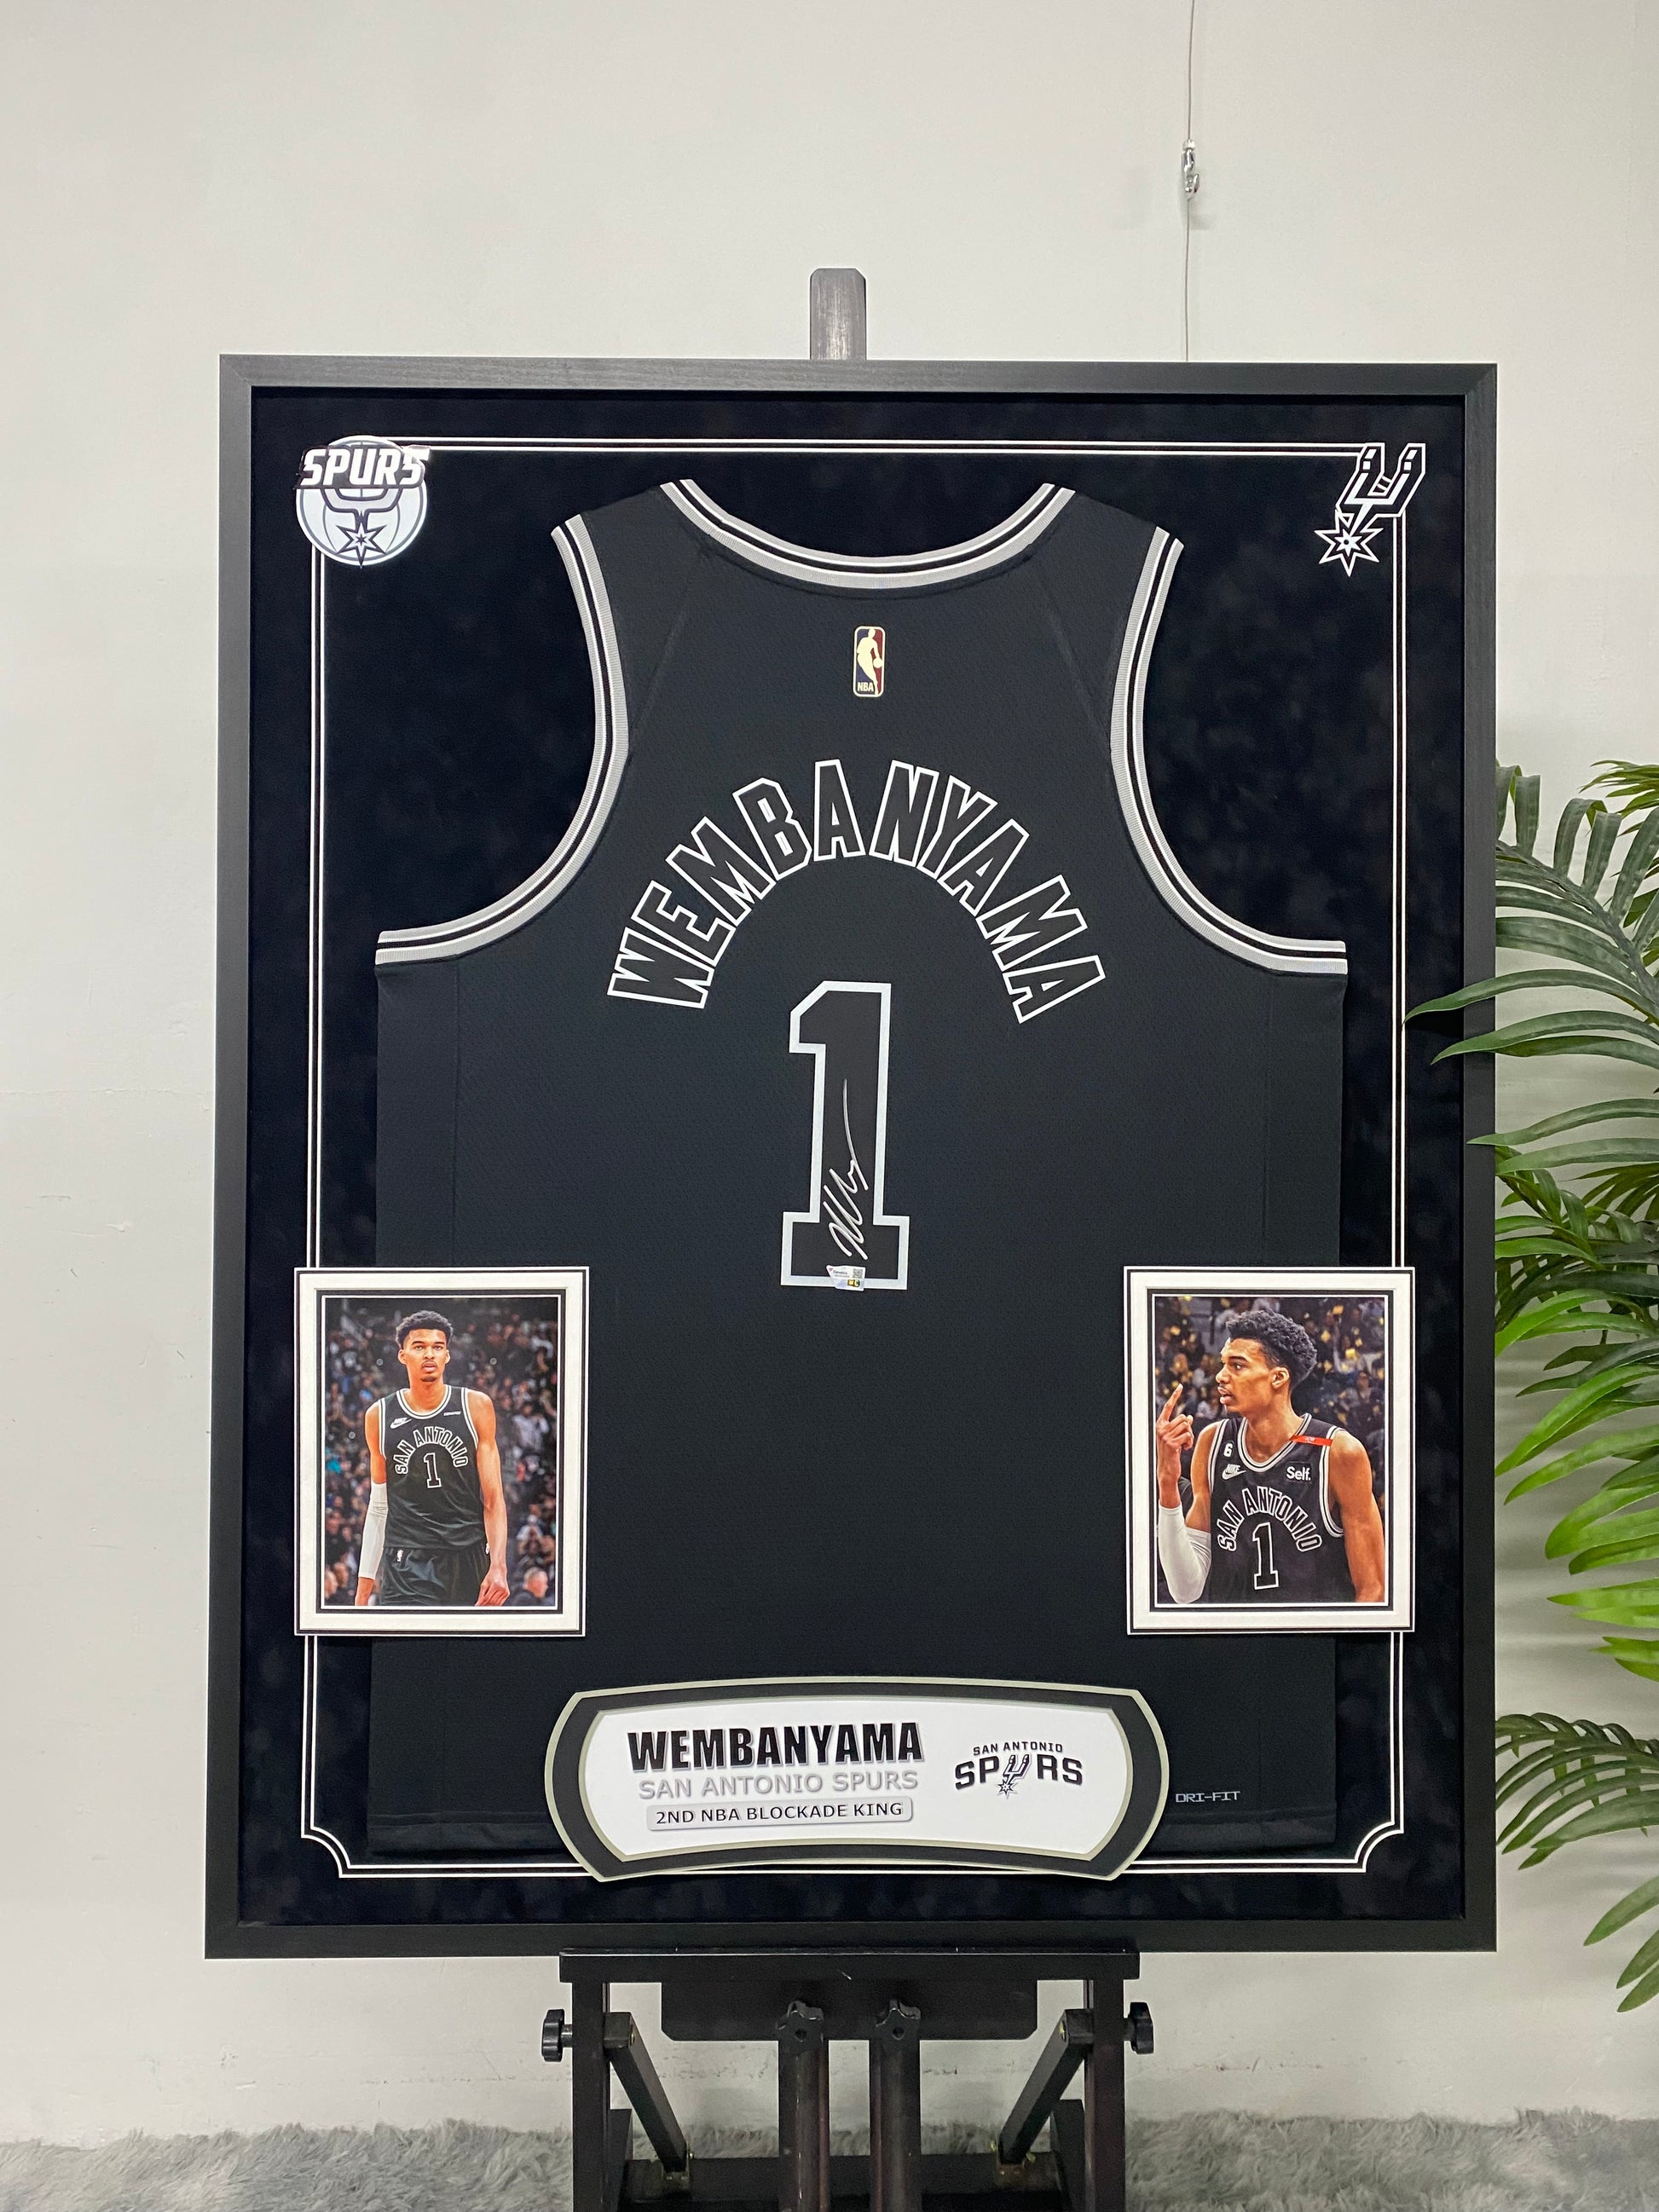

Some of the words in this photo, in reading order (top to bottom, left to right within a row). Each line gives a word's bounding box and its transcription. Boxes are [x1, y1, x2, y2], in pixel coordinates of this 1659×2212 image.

[300, 447, 430, 487] SPURS
[857, 682, 875, 692] NBA
[606, 759, 1107, 1025] WEMBANYAMA
[780, 980, 910, 1291] 1
[393, 1439, 417, 1475] SAN
[413, 1425, 469, 1468] ANTONIO
[1223, 1442, 1234, 1458] 6
[423, 1452, 442, 1489] 1
[1286, 1465, 1312, 1481] Self.
[1217, 1499, 1245, 1551] SAN
[1241, 1486, 1323, 1552] ANTONIO
[1252, 1522, 1280, 1591] 1
[627, 1722, 925, 1773] WEMBANYAMA
[973, 1742, 999, 1756] SAN
[1003, 1741, 1063, 1753] ANTONIO
[639, 1778, 692, 1800] SAN
[701, 1773, 824, 1798] ANTONIO
[831, 1770, 919, 1792] SPURS
[954, 1753, 1083, 1799] SPURS
[656, 1810, 695, 1825] 2ND
[701, 1808, 741, 1822] NBA
[746, 1803, 847, 1821] BLOCKADE
[853, 1801, 904, 1817] KING
[1175, 1790, 1241, 1804] DRI-FIT
